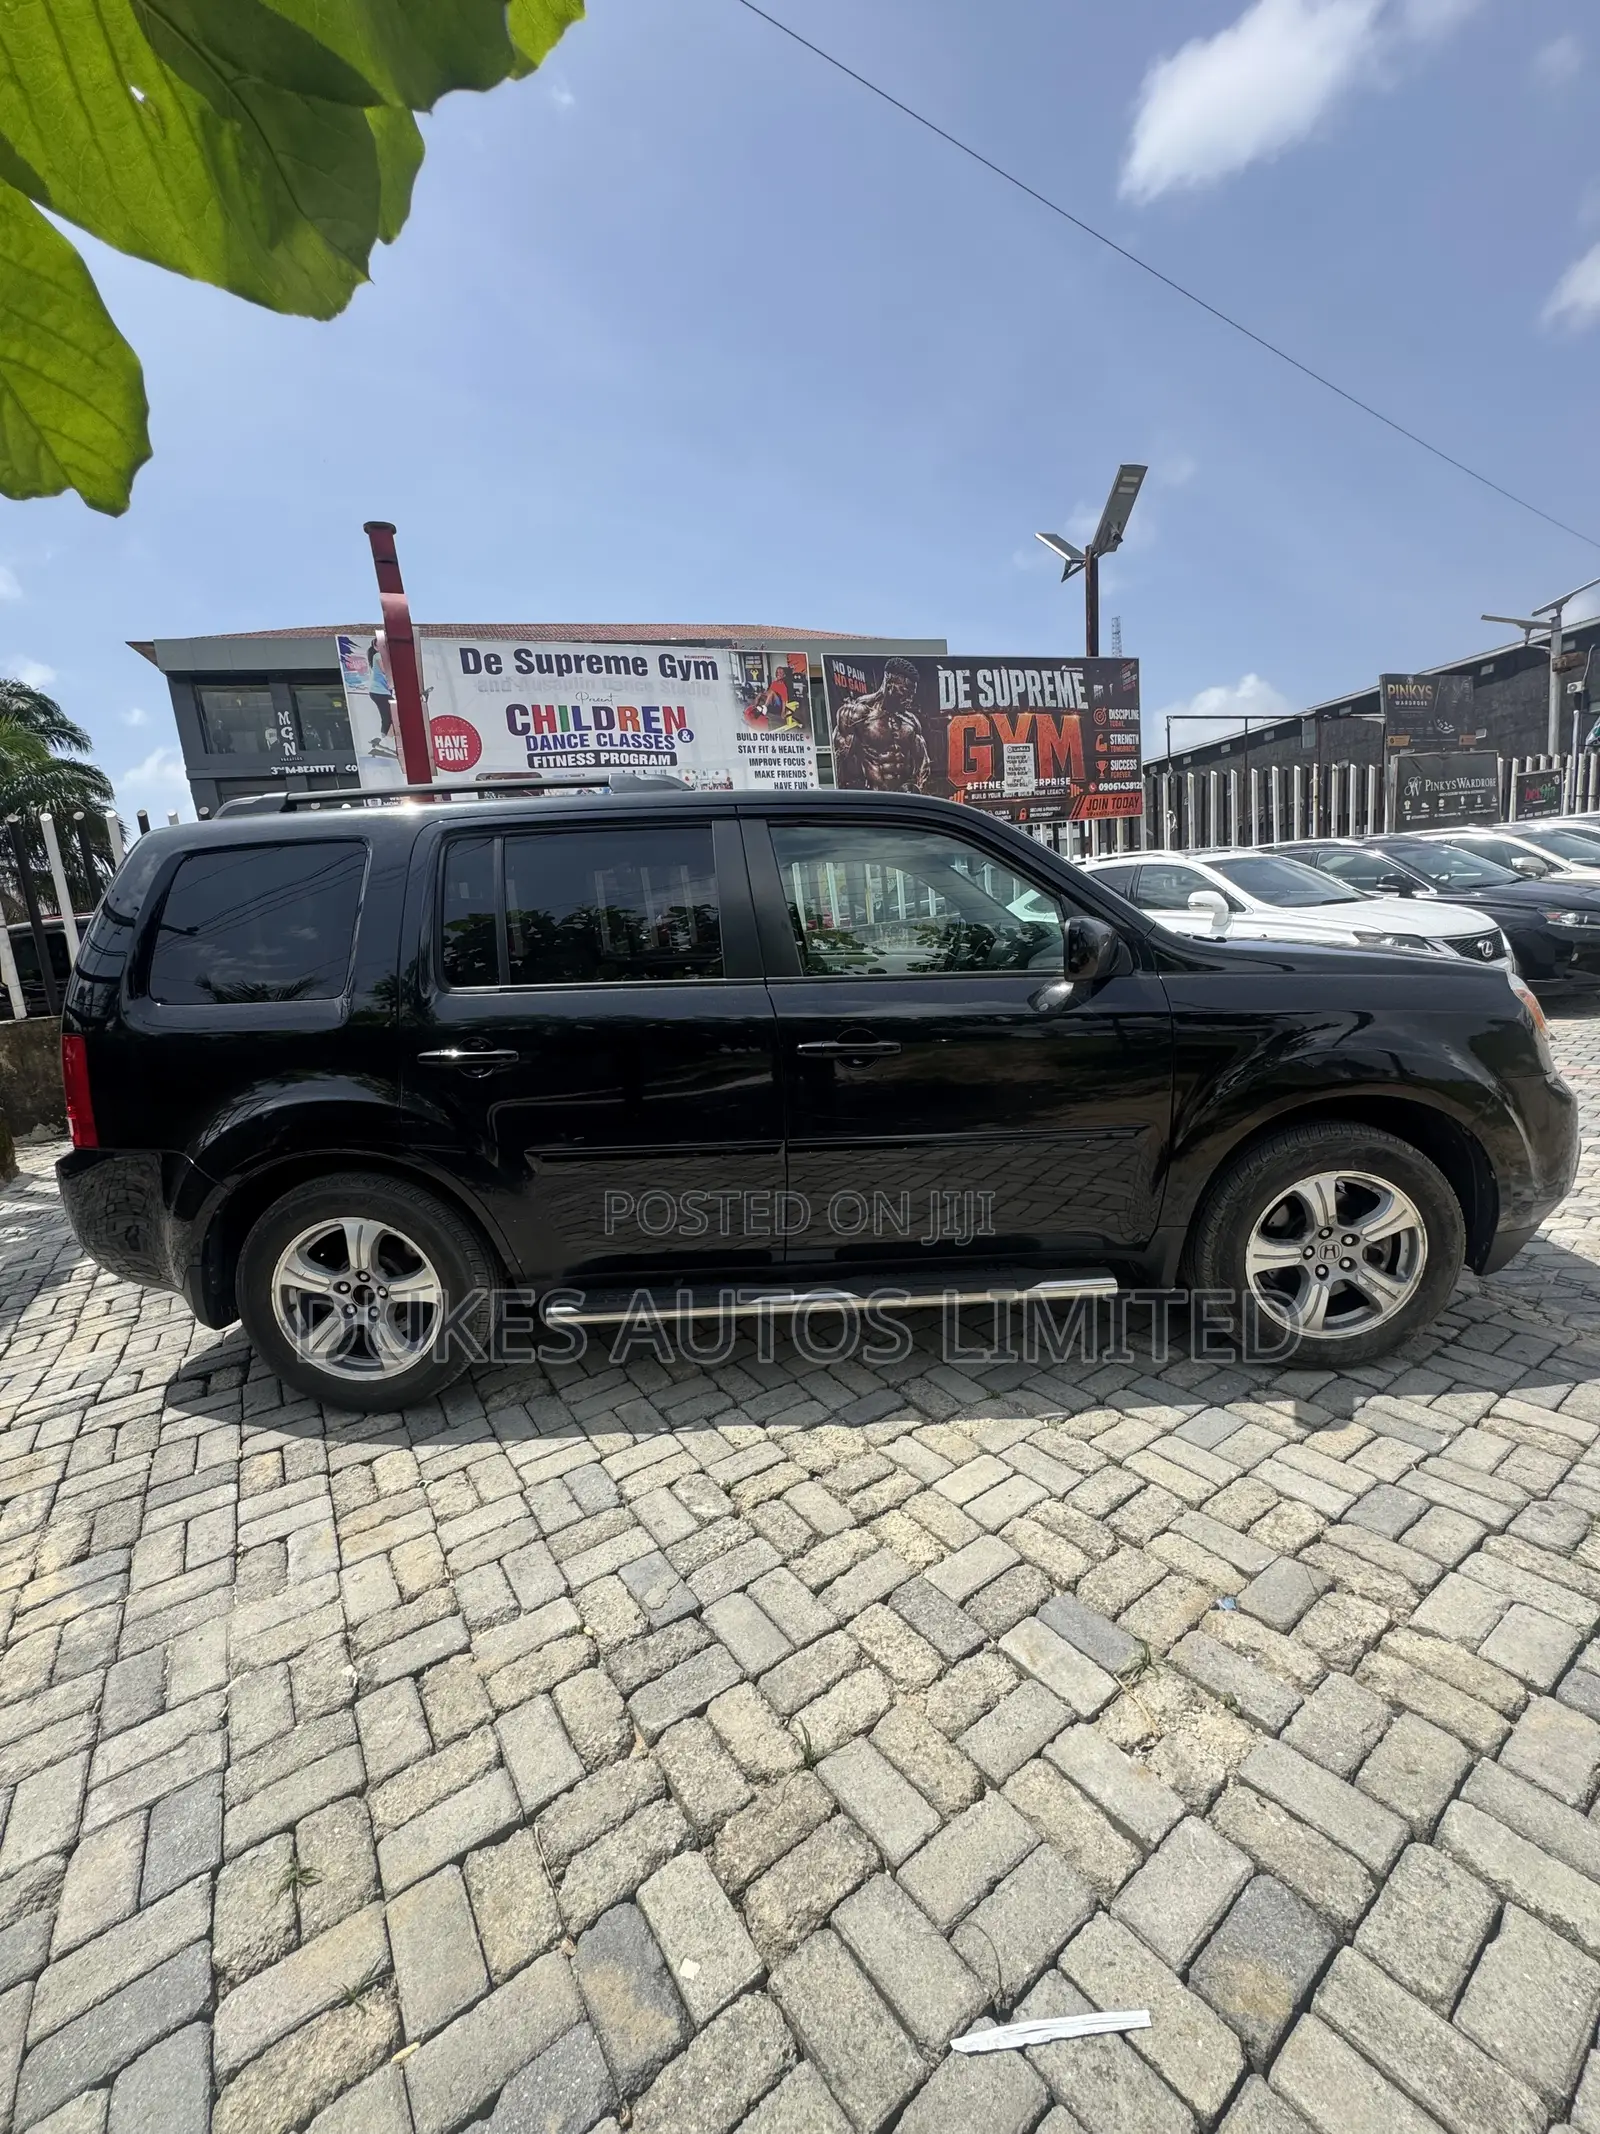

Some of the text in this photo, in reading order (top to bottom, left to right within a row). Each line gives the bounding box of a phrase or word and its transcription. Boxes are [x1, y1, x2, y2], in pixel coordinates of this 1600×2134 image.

[459, 647, 503, 675] De
[513, 648, 648, 677] Supreme
[658, 654, 719, 681] Gym
[832, 660, 866, 682] NO PAIN
[833, 673, 867, 694] NO GAIN
[938, 669, 972, 712] DE
[976, 669, 1089, 710] SUPREME
[1387, 684, 1433, 700] PINKYS
[506, 704, 687, 736] CHILDREN
[1109, 709, 1139, 720] DISCIPLINE
[434, 736, 468, 748] HAVE
[525, 729, 691, 751] DANCE CLASSES &
[736, 733, 804, 742] BUILD CONFIDENCE
[1110, 734, 1139, 745] STRENGTH
[438, 748, 468, 760] FUN!
[738, 745, 804, 754] STAY FIT & HEALTH
[947, 713, 1086, 787] GYM
[533, 752, 671, 768] FITNESS PROGRAM
[749, 758, 806, 766] IMPROVE FOCUS
[1110, 759, 1137, 770] SUCCESS
[755, 770, 806, 778] MAKE FRIENDS
[1087, 797, 1139, 811] JOIN TODAY
